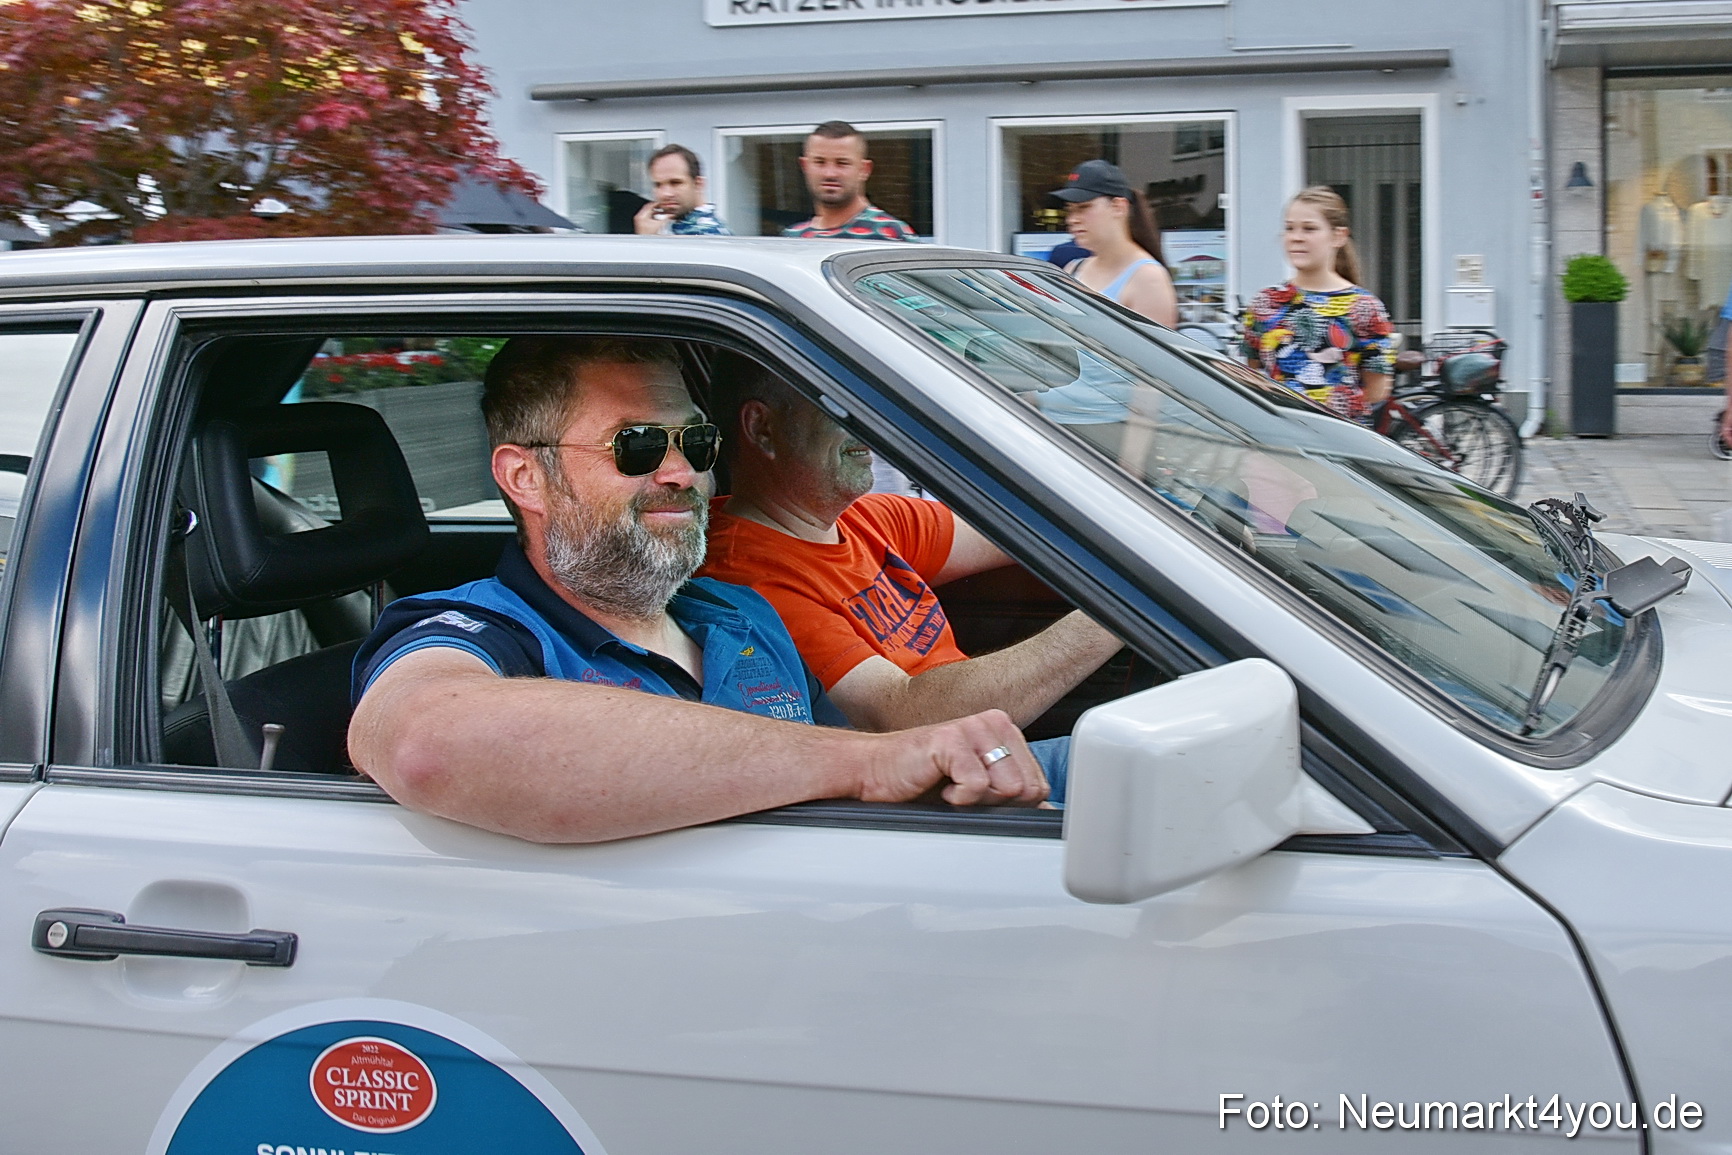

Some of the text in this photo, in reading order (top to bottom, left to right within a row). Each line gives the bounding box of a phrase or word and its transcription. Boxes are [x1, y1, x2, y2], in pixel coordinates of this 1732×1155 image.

[361, 1044, 380, 1054] 2022
[350, 1055, 395, 1068] Altmühltal
[326, 1066, 420, 1092] CLASSIC
[333, 1087, 413, 1112] SPRINT
[352, 1111, 398, 1127] Das Original
